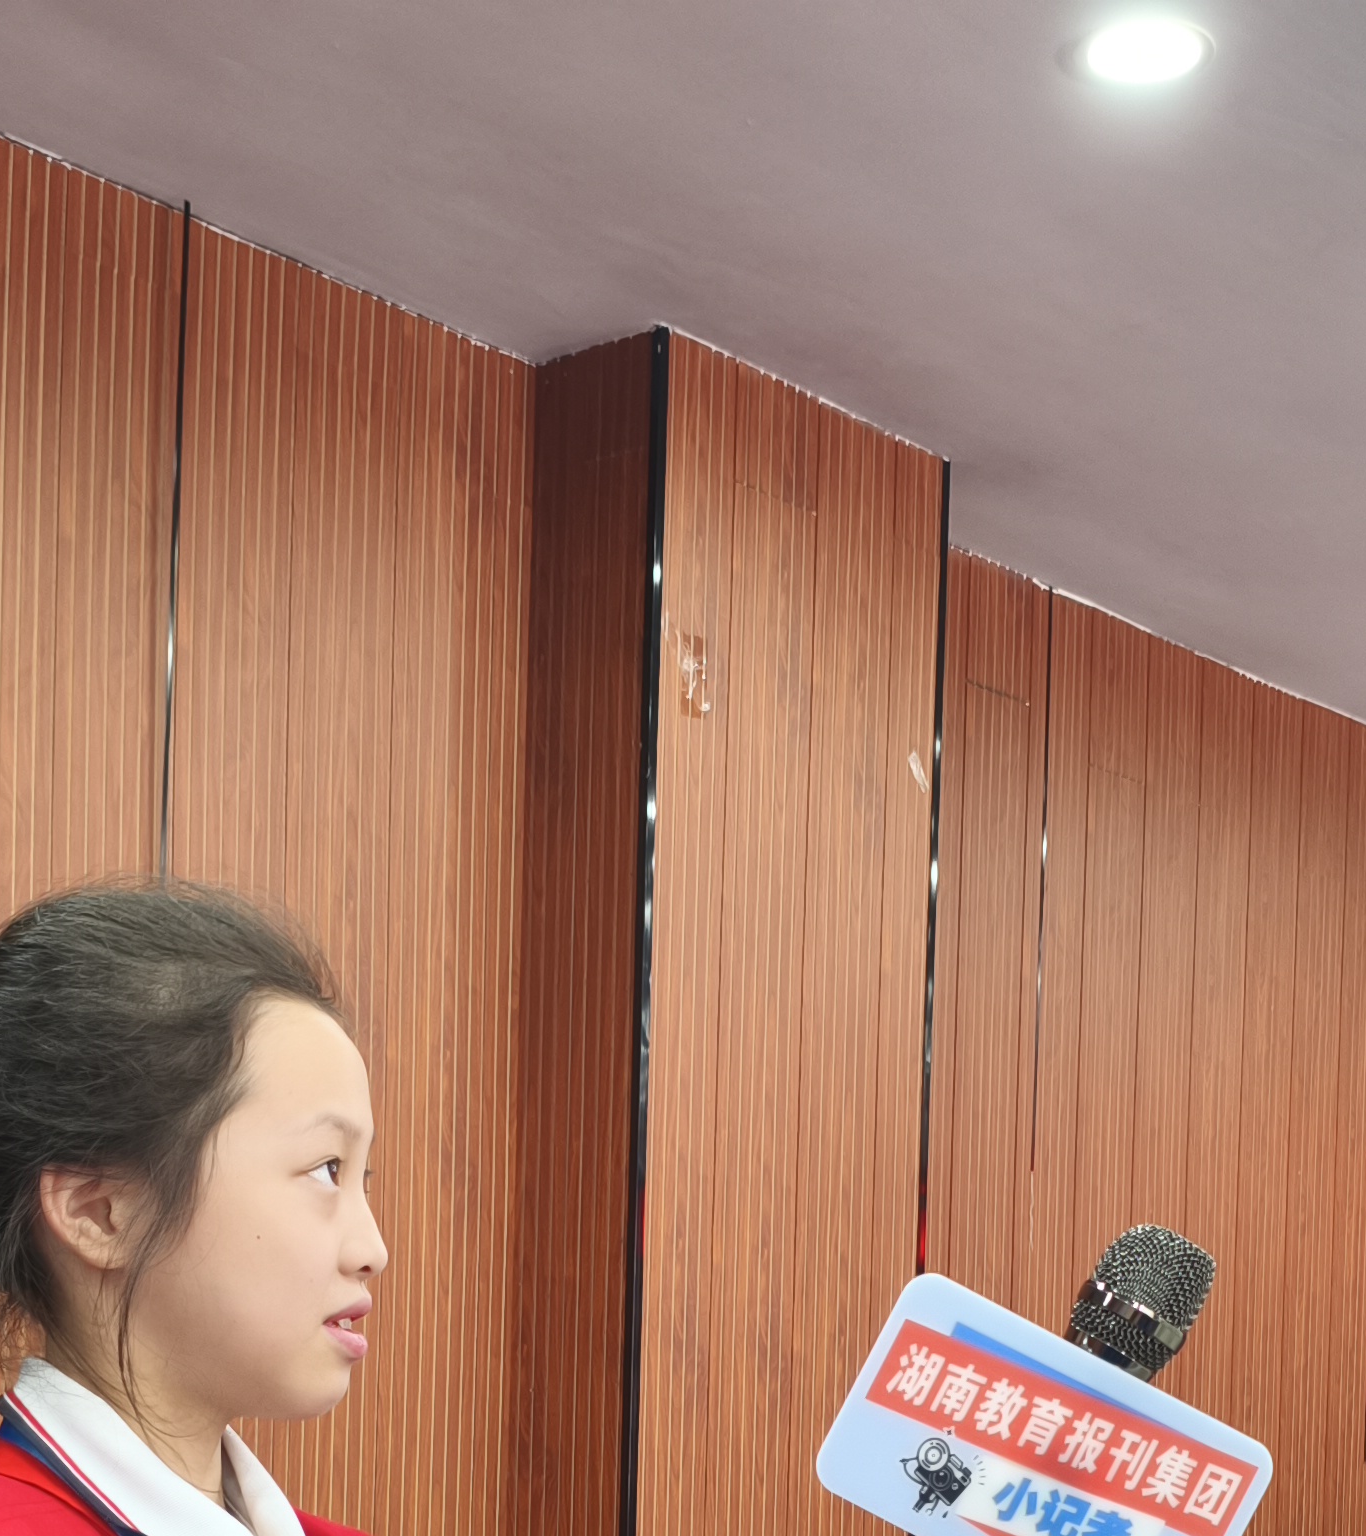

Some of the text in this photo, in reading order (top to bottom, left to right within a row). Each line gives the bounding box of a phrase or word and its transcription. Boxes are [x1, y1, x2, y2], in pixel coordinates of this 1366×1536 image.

[886, 1343, 1242, 1525] 湖南教育报刊集团
